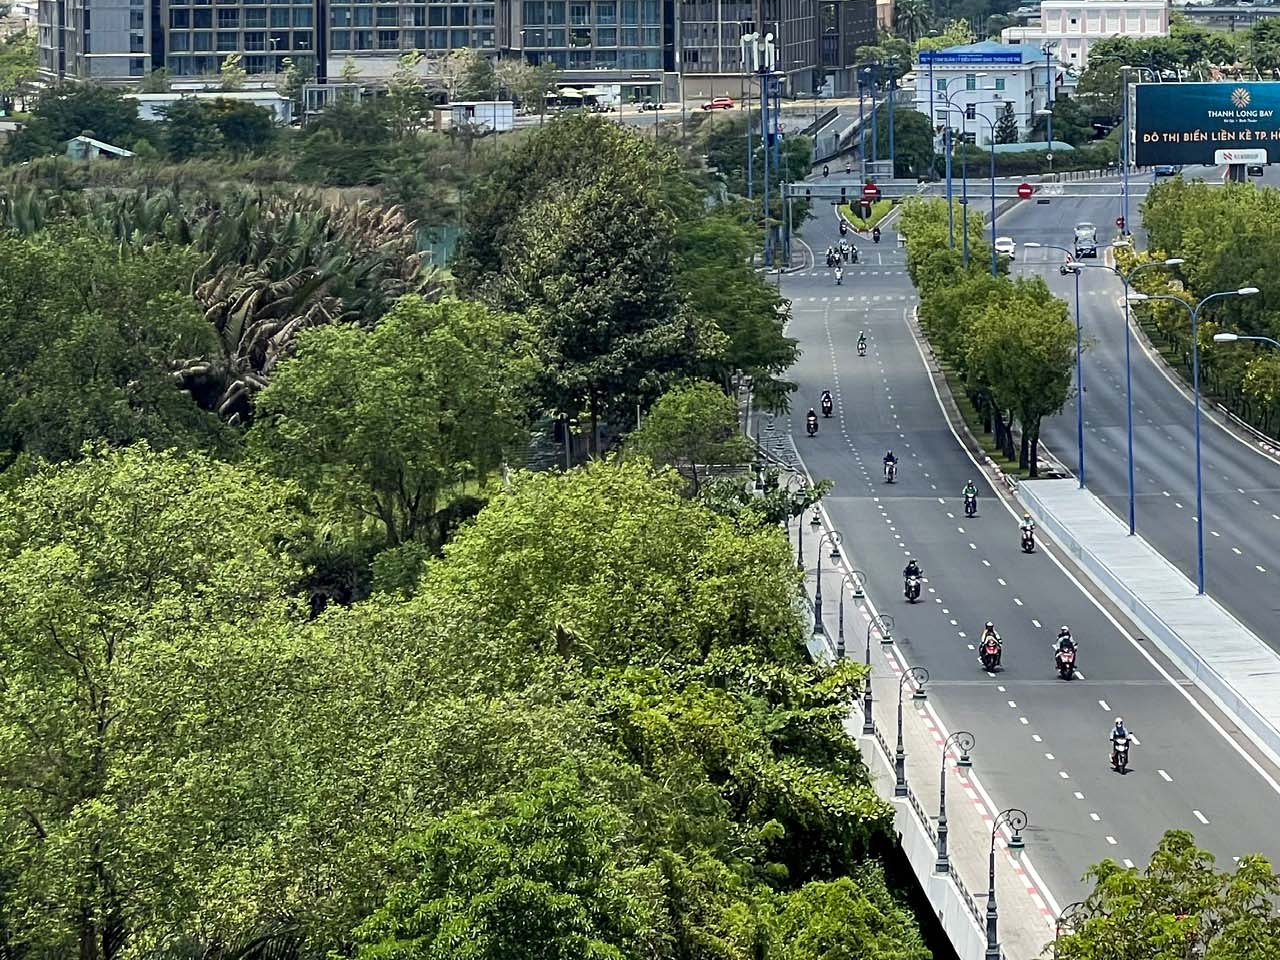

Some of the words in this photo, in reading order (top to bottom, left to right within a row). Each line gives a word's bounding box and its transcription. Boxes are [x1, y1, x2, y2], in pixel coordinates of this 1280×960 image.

[1143, 131, 1159, 142] ĐÔ
[1162, 133, 1179, 143] THỊ
[1211, 129, 1235, 141] LIỀN
[1239, 129, 1252, 140] KỀ
[1255, 131, 1268, 140] TP.
